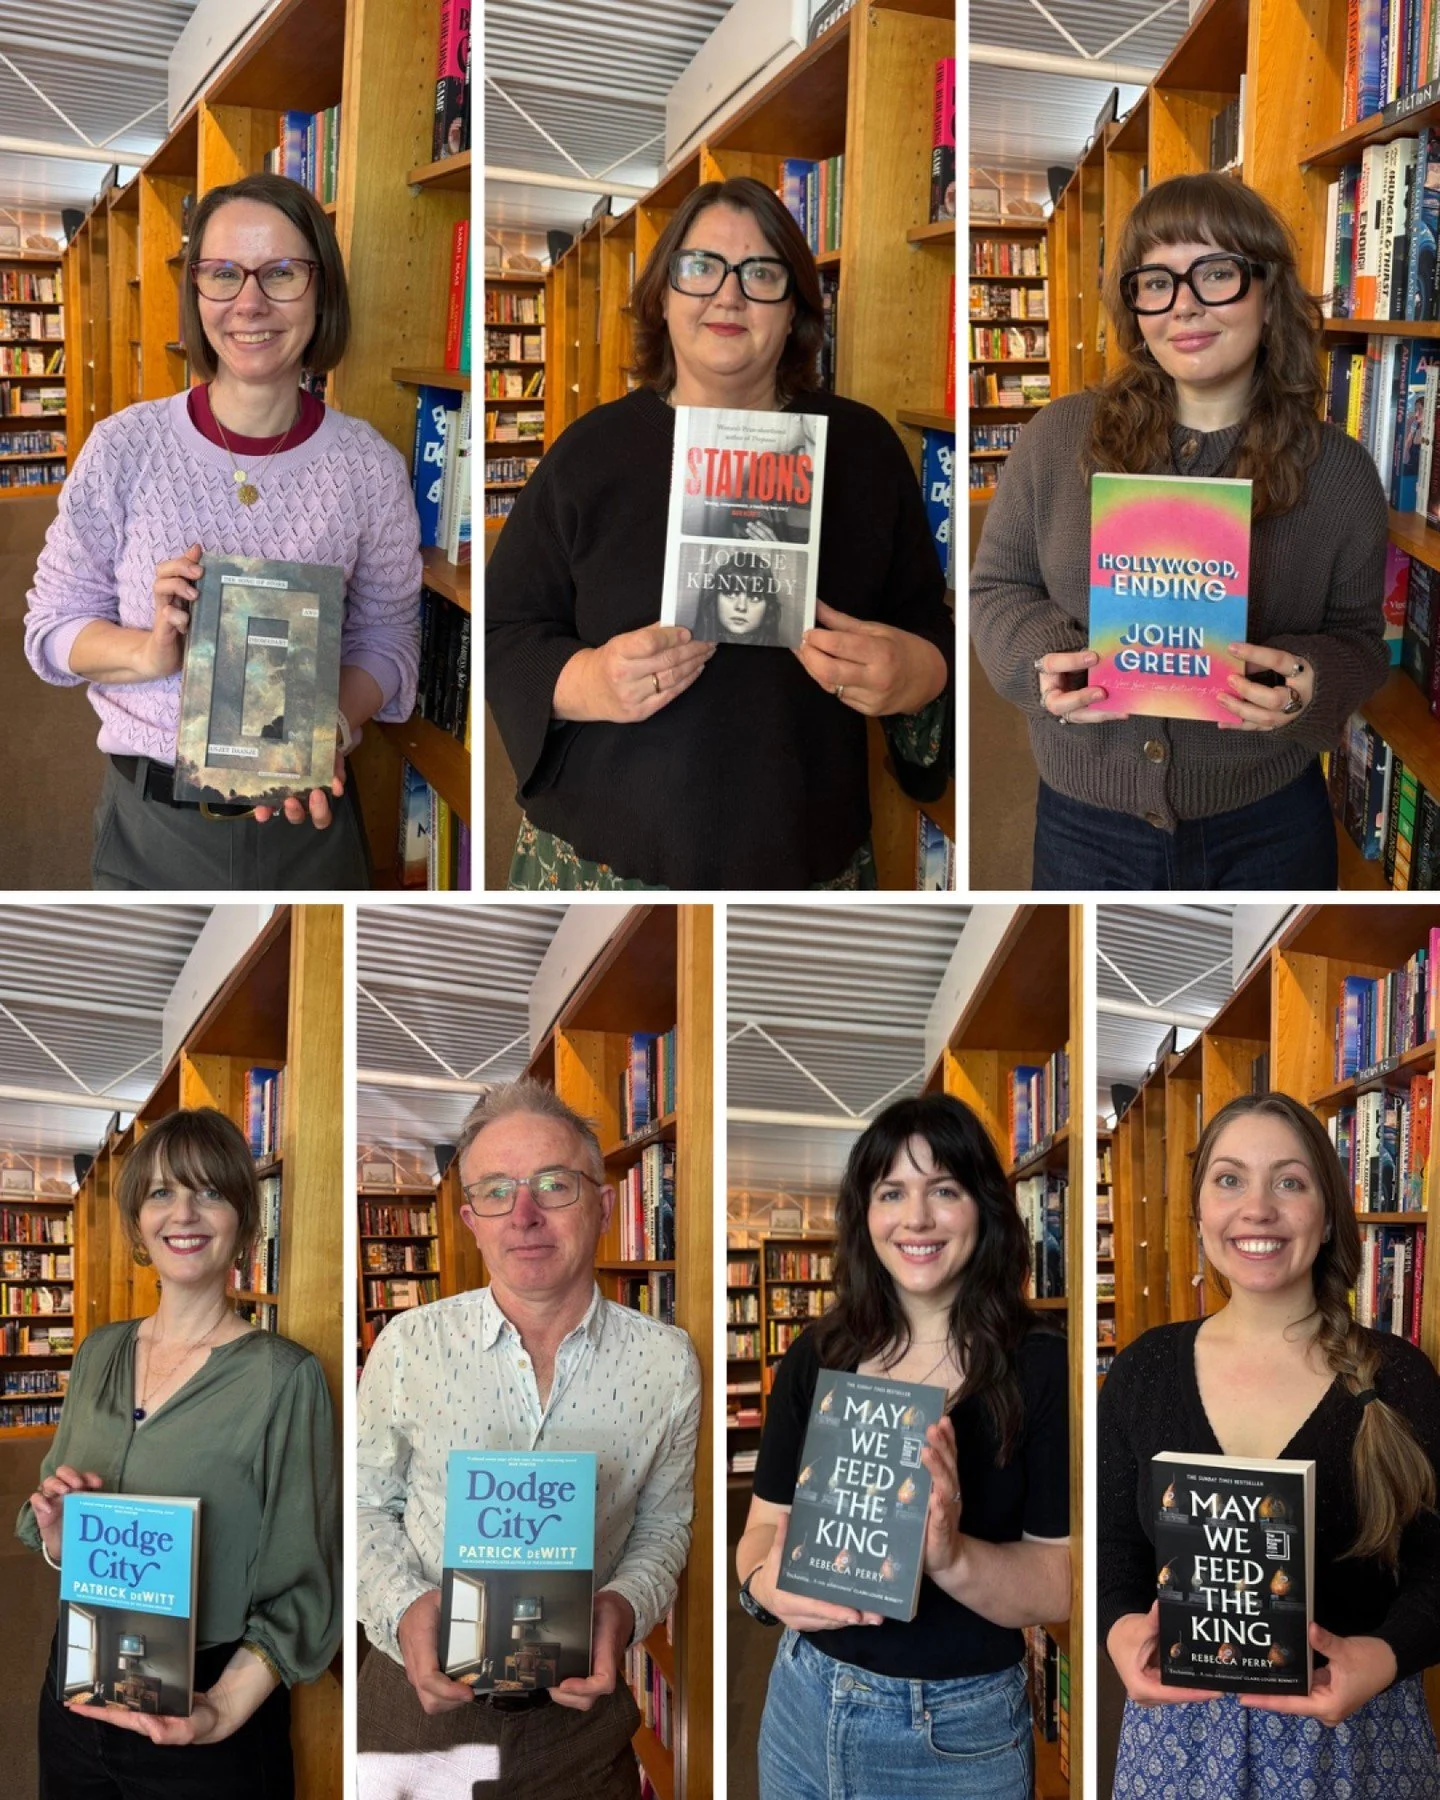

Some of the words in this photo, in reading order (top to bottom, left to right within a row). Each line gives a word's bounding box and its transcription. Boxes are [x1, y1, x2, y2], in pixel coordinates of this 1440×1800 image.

[936, 65, 945, 86] THE
[435, 80, 447, 115] GAME
[932, 148, 942, 177] GAME
[1417, 134, 1426, 185] PATRICK
[1413, 188, 1422, 222] GALE
[457, 225, 465, 253] SARAH
[1357, 211, 1369, 271] ENOUGH
[1410, 236, 1419, 266] LOVE
[453, 262, 462, 287] MAAS
[1382, 253, 1392, 298] THIRST
[1407, 270, 1416, 302] LANE
[1399, 345, 1410, 395] Almost
[1396, 397, 1406, 424] Life
[685, 446, 814, 504] STATIONS
[699, 549, 788, 571] LOUISE
[1099, 553, 1240, 579] HOLLYWOOD,
[687, 572, 797, 597] KENNEDY
[1112, 574, 1227, 602] ENDING
[1120, 623, 1205, 649] JOHN
[1115, 650, 1212, 676] GREEN
[1388, 813, 1399, 861] KILLINGS
[843, 1396, 907, 1430] MAY
[851, 1428, 890, 1459] WE
[834, 1456, 895, 1490] FEED
[1198, 1475, 1217, 1483] SUNDAY
[466, 1470, 576, 1509] Dodge
[834, 1487, 886, 1524] THE
[1189, 1490, 1262, 1523] MAY
[79, 1513, 173, 1557] Dodge
[477, 1506, 562, 1545] City
[815, 1517, 889, 1558] KING
[1203, 1524, 1251, 1554] WE
[459, 1545, 522, 1559] PATRICK
[88, 1548, 161, 1588] City
[809, 1557, 851, 1576] REBECCA
[855, 1566, 885, 1584] PERRY
[1194, 1555, 1264, 1585] FEED
[73, 1581, 126, 1599] PATRICK
[1199, 1586, 1261, 1616] THE
[1192, 1615, 1272, 1647] KING
[1192, 1652, 1237, 1666] REBECCA
[1242, 1657, 1274, 1668] PERRY
